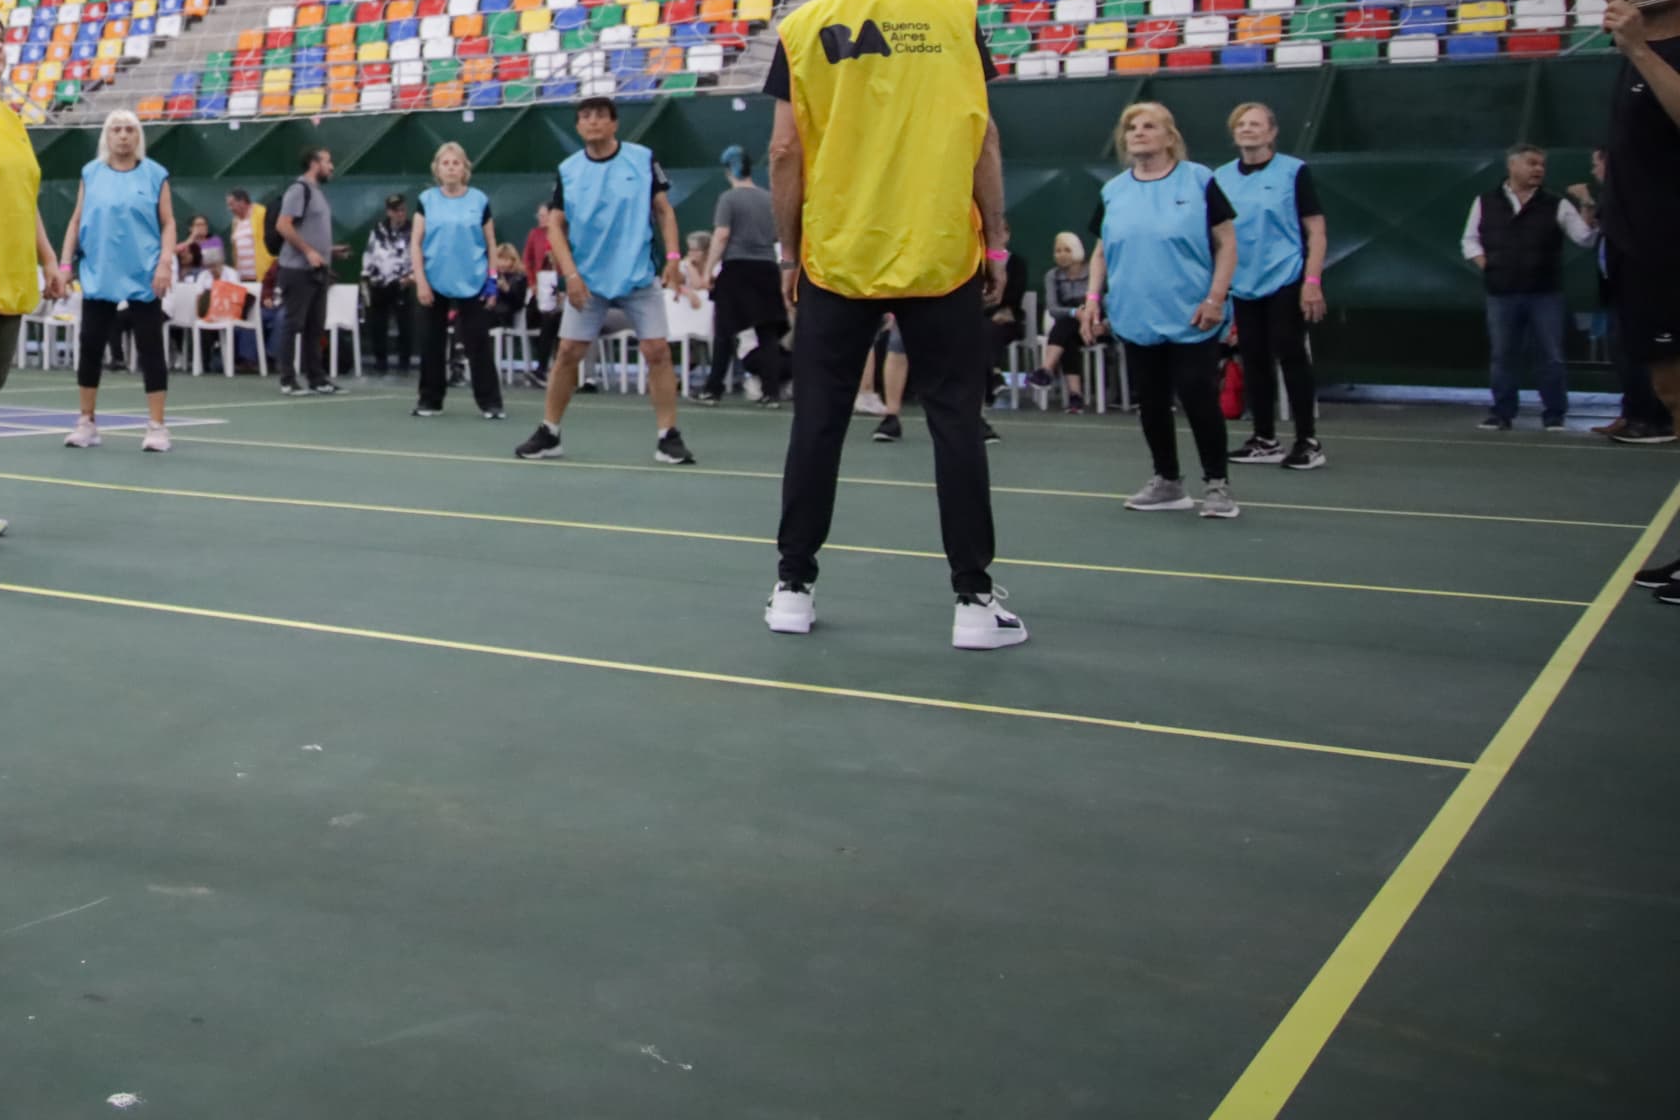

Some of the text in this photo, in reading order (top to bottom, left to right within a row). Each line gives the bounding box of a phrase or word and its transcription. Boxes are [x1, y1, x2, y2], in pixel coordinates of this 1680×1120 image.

[881, 22, 931, 31] Buenos
[890, 32, 926, 41] Aires
[895, 43, 942, 53] Ciudad
